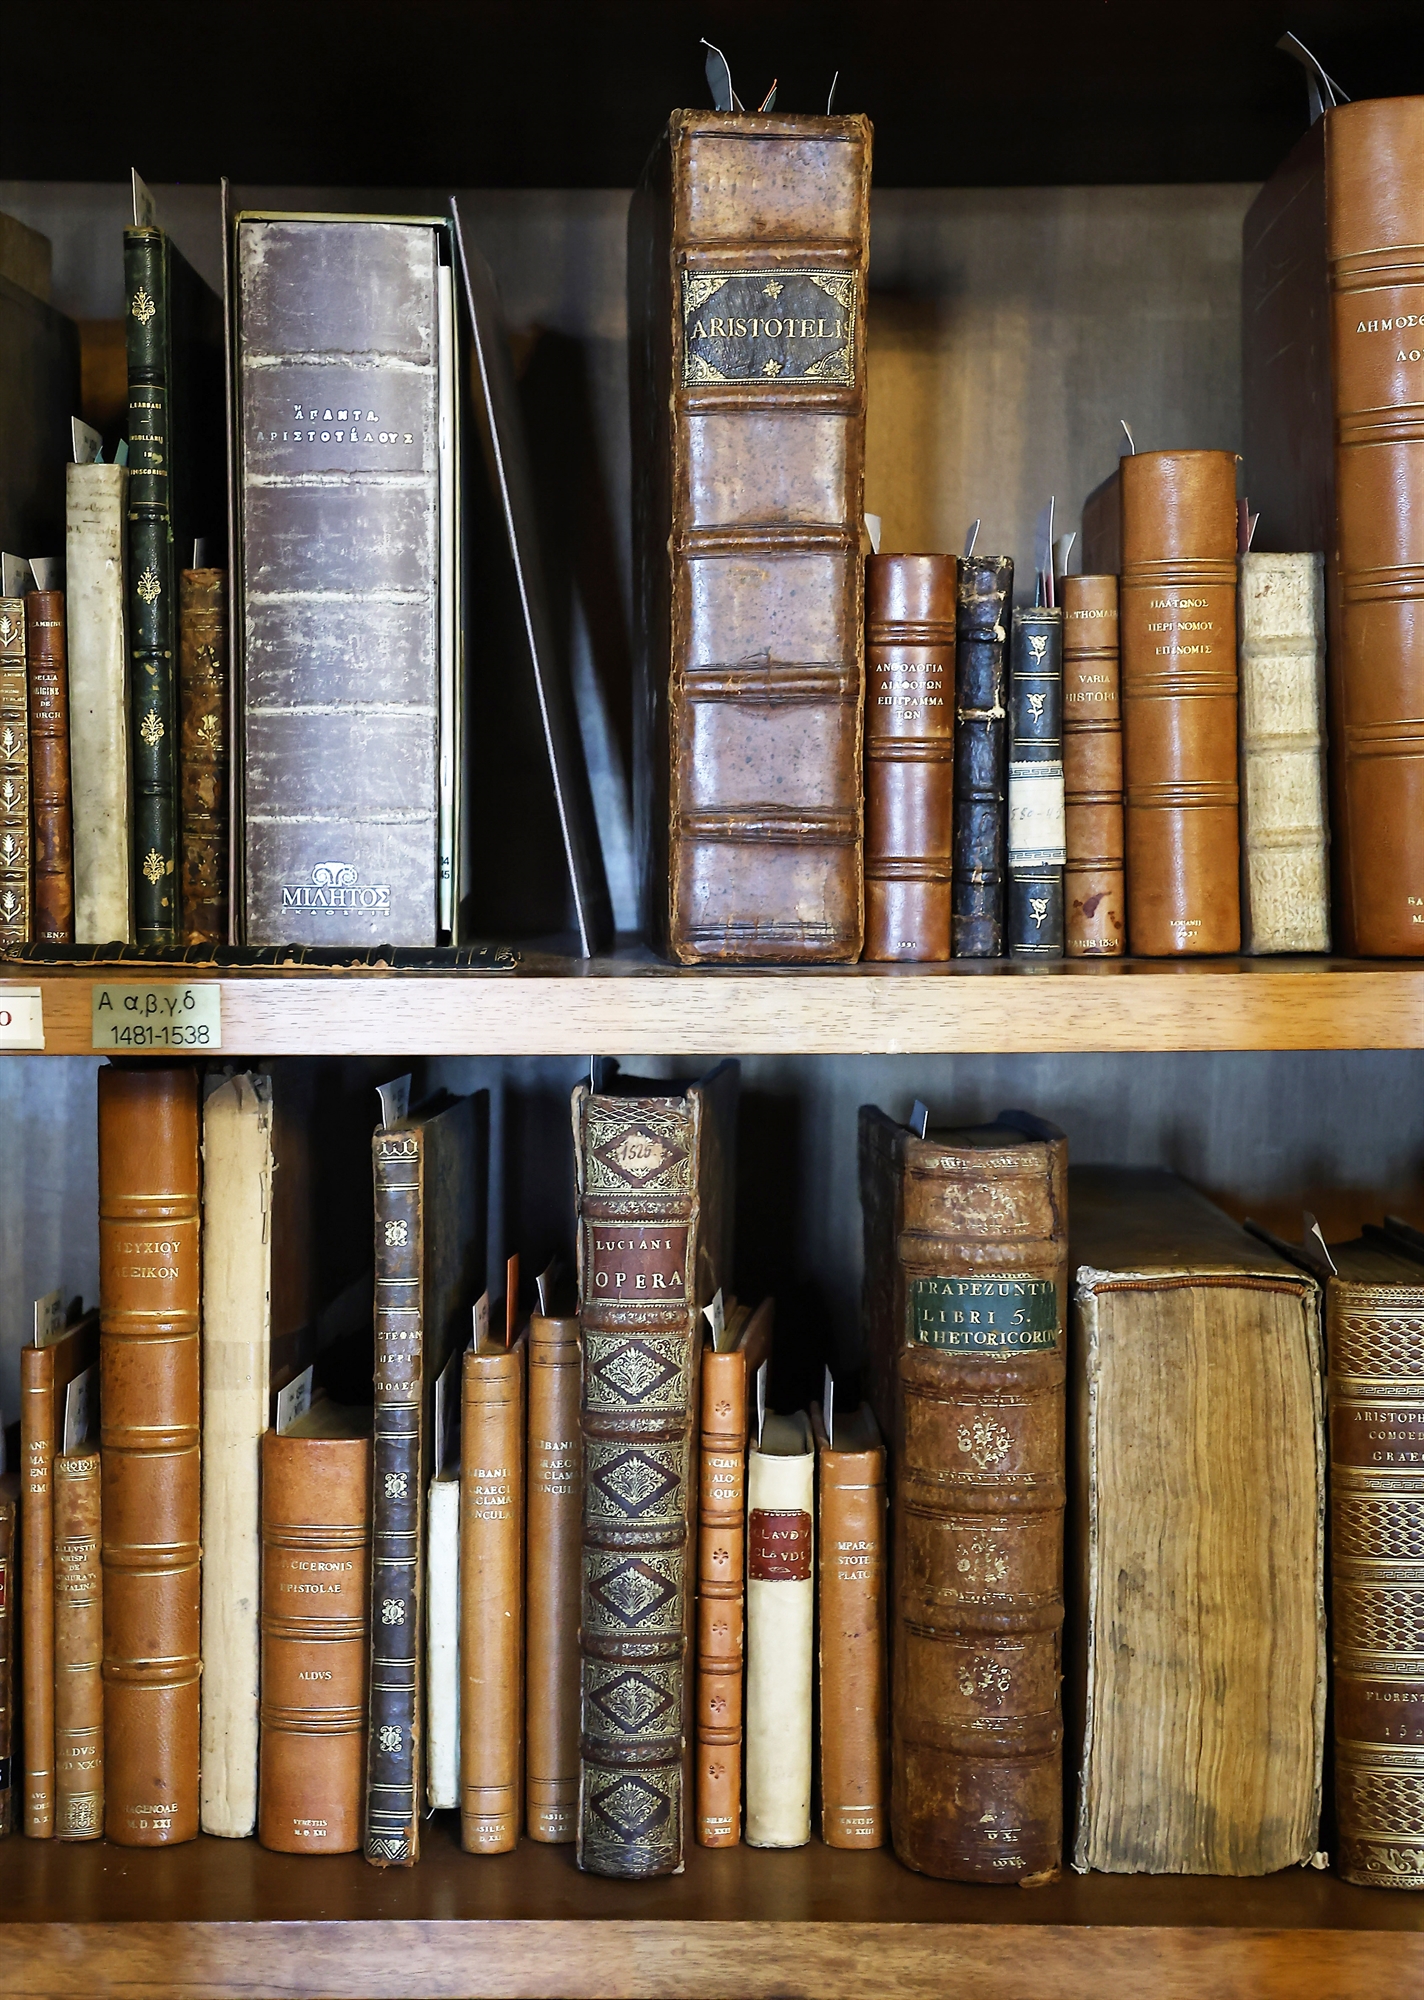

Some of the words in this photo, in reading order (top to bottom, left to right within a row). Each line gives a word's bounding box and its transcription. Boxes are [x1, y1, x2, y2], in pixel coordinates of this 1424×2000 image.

[282, 887, 391, 907] ΜΙΛΗΤΟΣ
[111, 1024, 210, 1045] 1481-1538
[596, 1240, 672, 1250] LUCIANI
[595, 1271, 683, 1289] OPERA
[922, 1309, 996, 1324] LIBRI
[1373, 1451, 1424, 1462] GRAE
[298, 1671, 332, 1680] ALDVS
